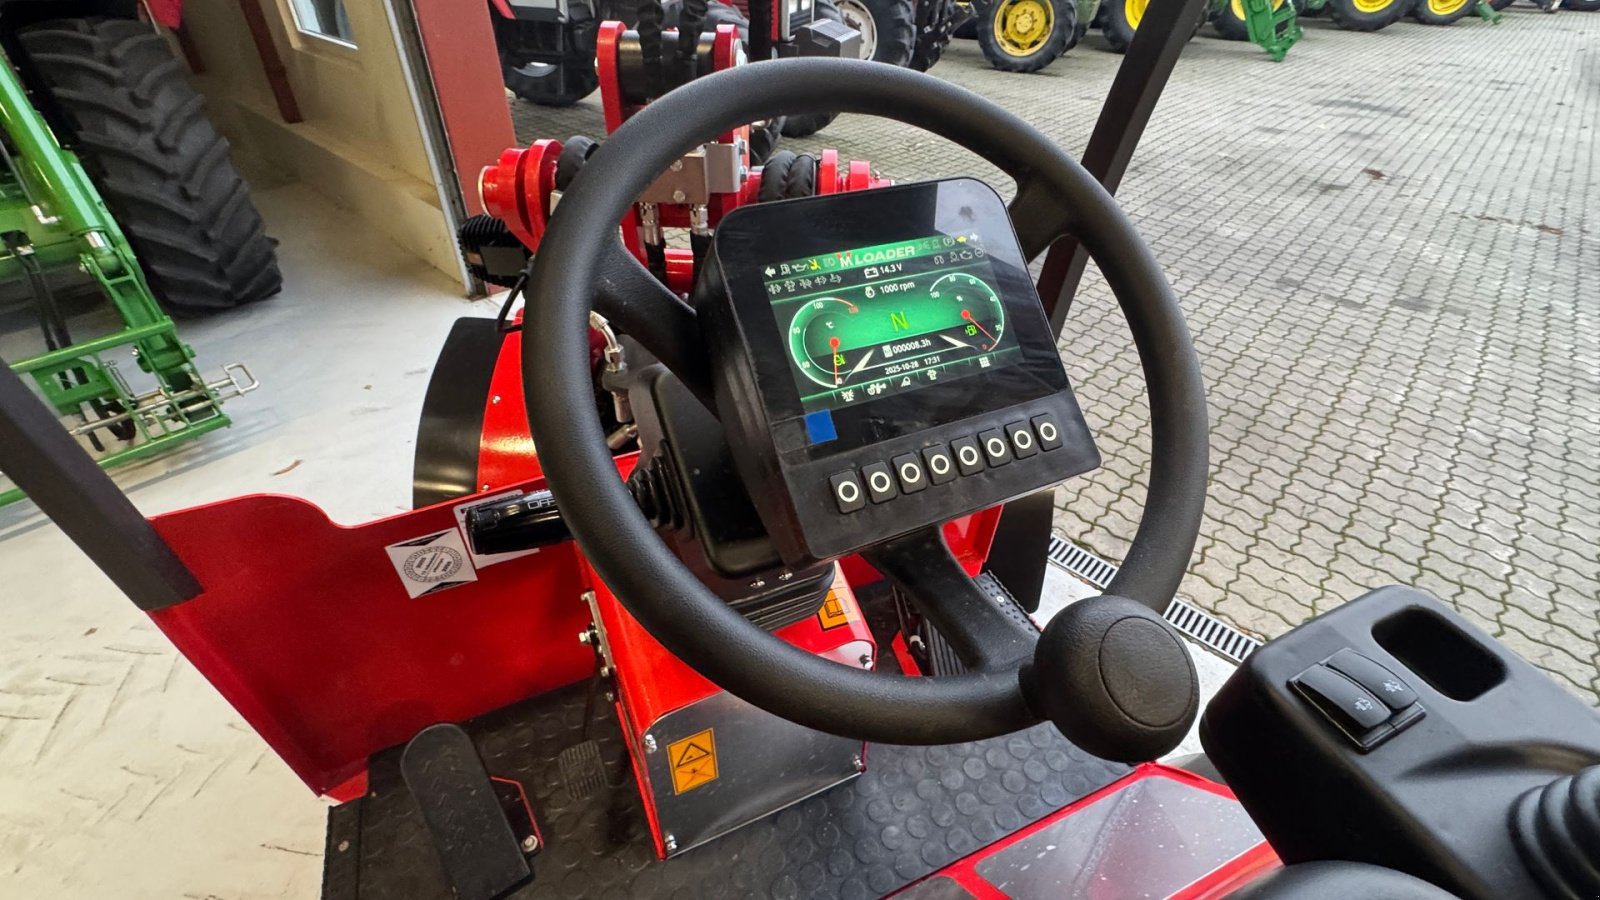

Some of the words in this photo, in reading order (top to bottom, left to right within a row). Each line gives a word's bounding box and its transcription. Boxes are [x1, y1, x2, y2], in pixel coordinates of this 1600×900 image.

[855, 246, 915, 265] LOADER
[880, 264, 897, 274] 14.3
[896, 263, 902, 272] V
[880, 283, 898, 294] 1000
[899, 281, 915, 292] rpm
[890, 311, 910, 332] N
[892, 338, 932, 354] 000008.3h
[885, 360, 919, 375] 2025-10-28
[528, 497, 555, 510] OFF
